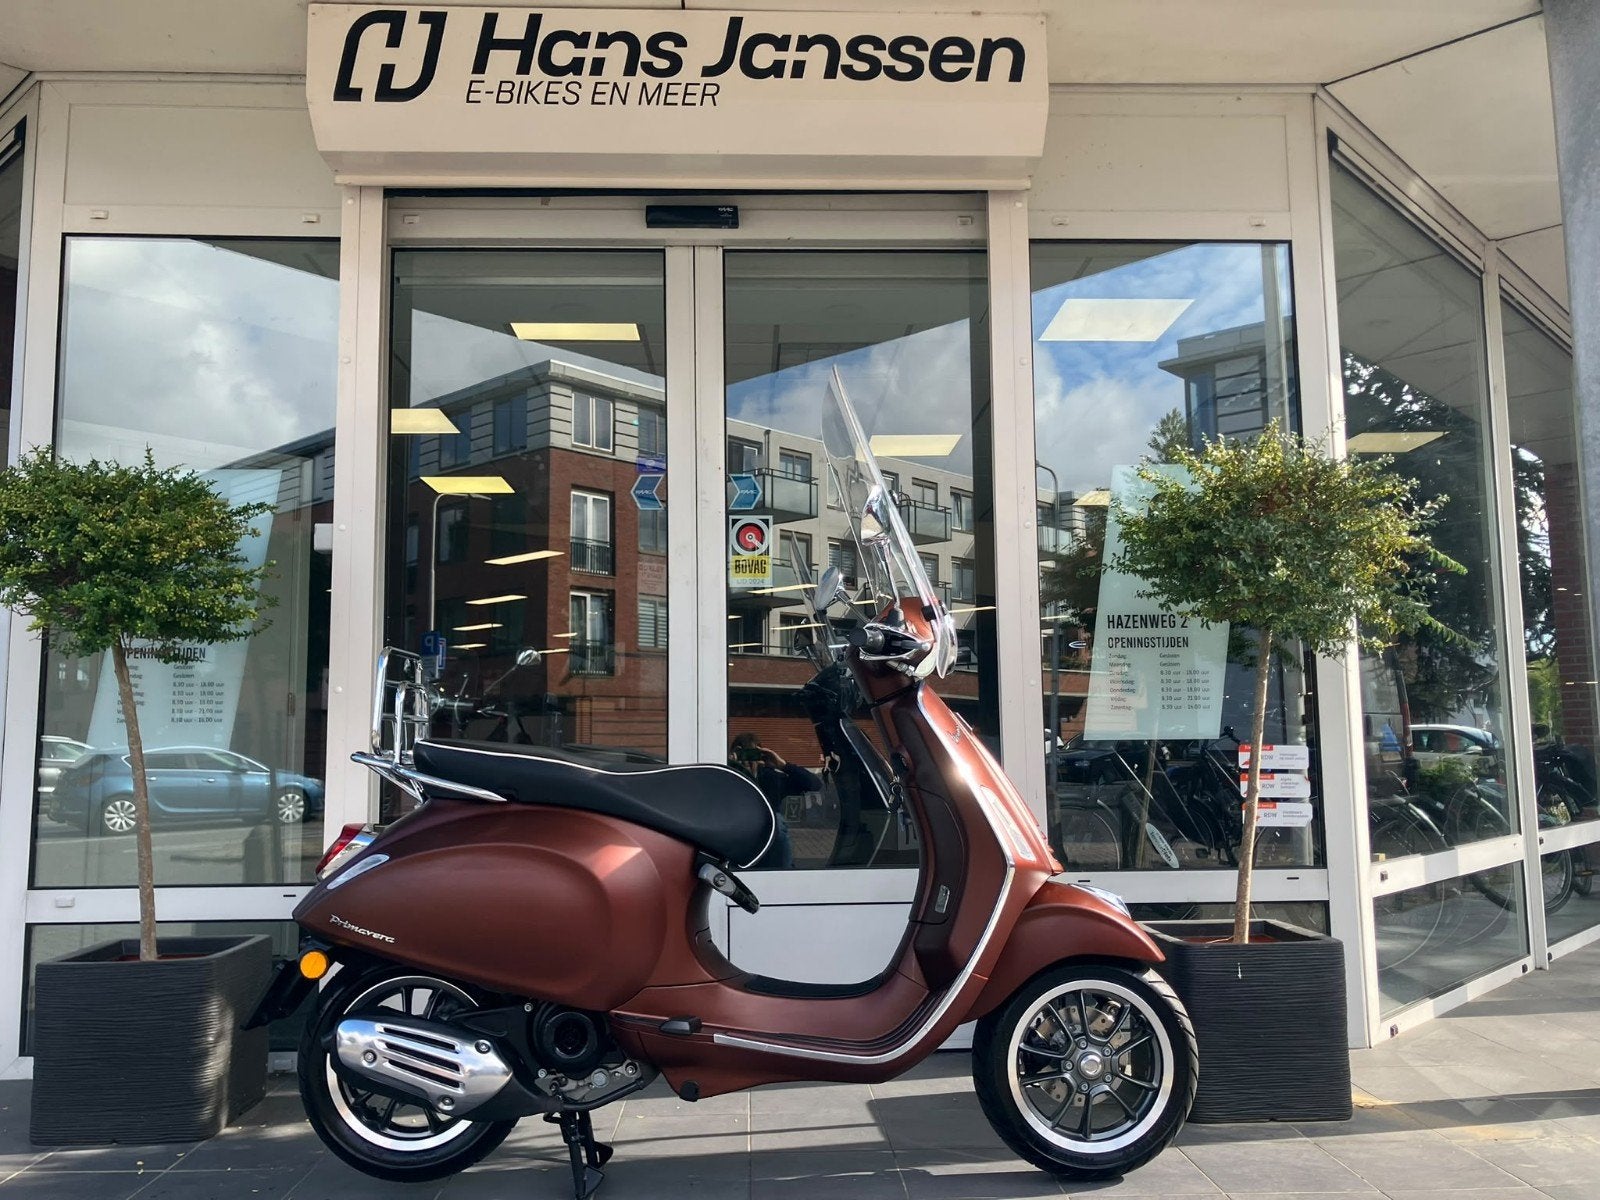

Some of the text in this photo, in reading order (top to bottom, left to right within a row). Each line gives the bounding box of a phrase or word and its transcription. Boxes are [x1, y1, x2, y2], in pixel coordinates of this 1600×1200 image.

[471, 12, 1026, 82] Hans Janssen
[465, 79, 721, 107] E-BIKES EN MEER
[734, 560, 766, 574] BOVAG
[1107, 614, 1176, 629] HAZENWEG
[1107, 637, 1189, 649] OPENINGSTIJDEN
[122, 647, 206, 660] PENINTIJDEN
[329, 914, 396, 944] Primavera
